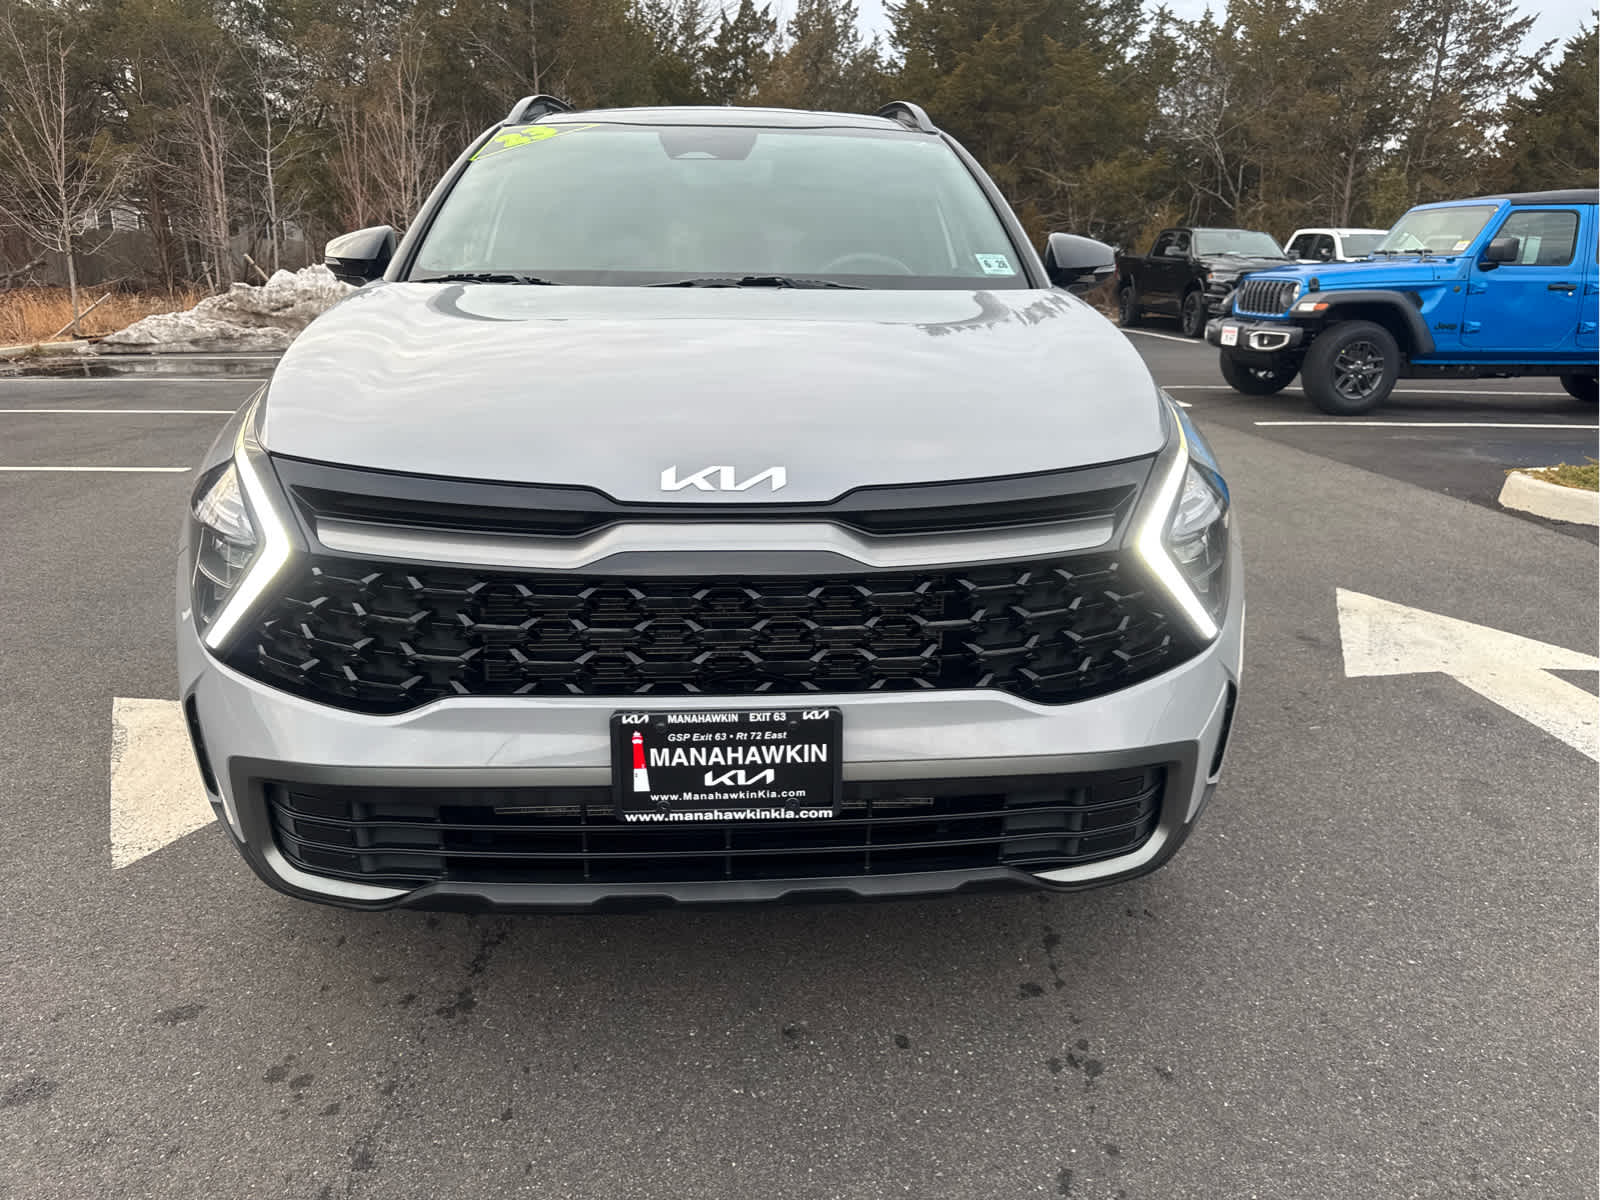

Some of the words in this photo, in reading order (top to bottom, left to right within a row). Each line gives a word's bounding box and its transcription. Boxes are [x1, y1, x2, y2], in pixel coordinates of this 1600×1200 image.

[660, 464, 787, 492] KIA
[622, 714, 649, 724] KIA
[667, 713, 739, 724] MANAHAWKIN
[749, 712, 771, 722] EXIT
[773, 712, 787, 721] 63
[802, 710, 830, 720] KIA
[667, 732, 691, 742] GSP
[692, 732, 713, 741] Exit
[714, 732, 727, 741] 63
[736, 731, 748, 740] Rt
[750, 731, 762, 740] 72
[764, 731, 788, 739] East
[649, 743, 828, 767] MANAHAWKIN
[704, 768, 775, 786] KIA
[650, 790, 806, 801] www.ManahawkinKia.com
[624, 808, 833, 822] www.manahawkinkia.com
